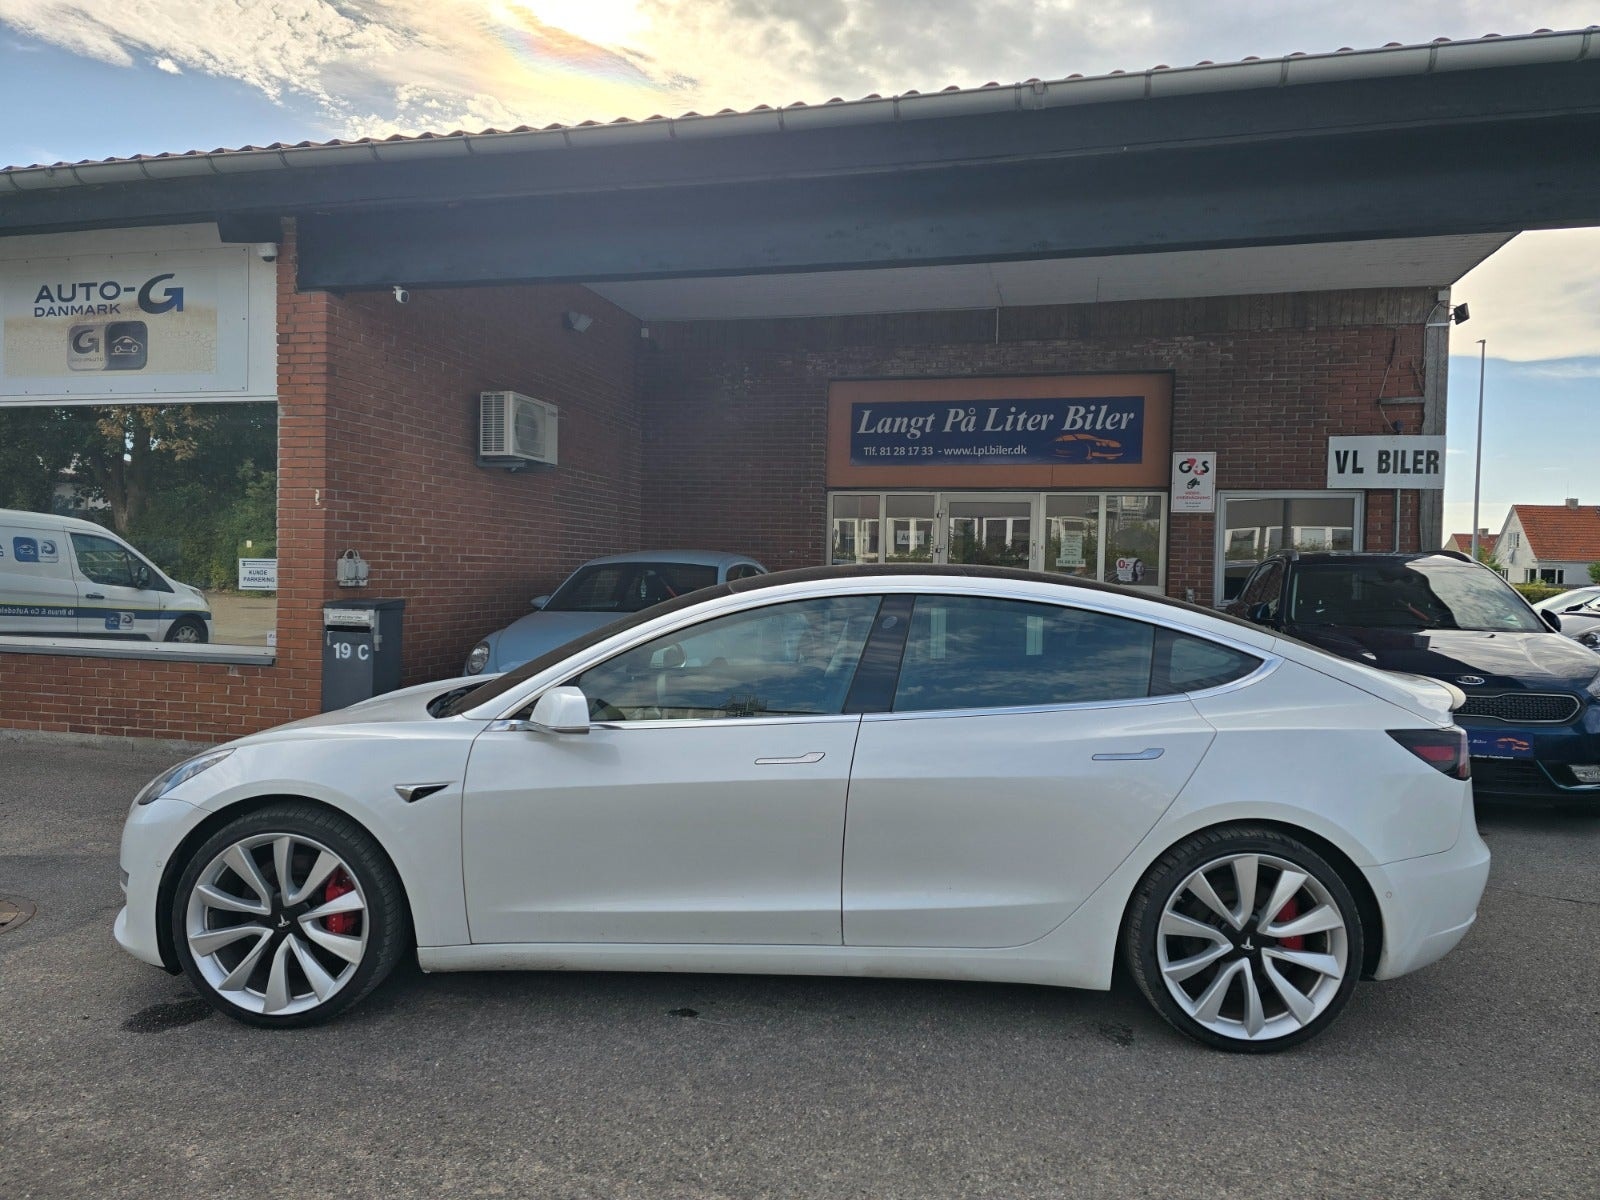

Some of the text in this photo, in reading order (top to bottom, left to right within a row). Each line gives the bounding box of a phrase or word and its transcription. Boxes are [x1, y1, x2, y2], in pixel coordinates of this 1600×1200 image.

[34, 303, 121, 318] DANMARK
[857, 404, 1135, 440] Langt På Liter Biler
[863, 446, 878, 456] Tlf.
[880, 446, 891, 456] 81
[893, 446, 906, 456] 28
[907, 446, 919, 456] 17
[921, 446, 934, 456] 33
[944, 445, 1028, 458] www.LpLbiler.dk
[1335, 449, 1440, 474] VL BILER
[333, 642, 369, 661] 19 C
